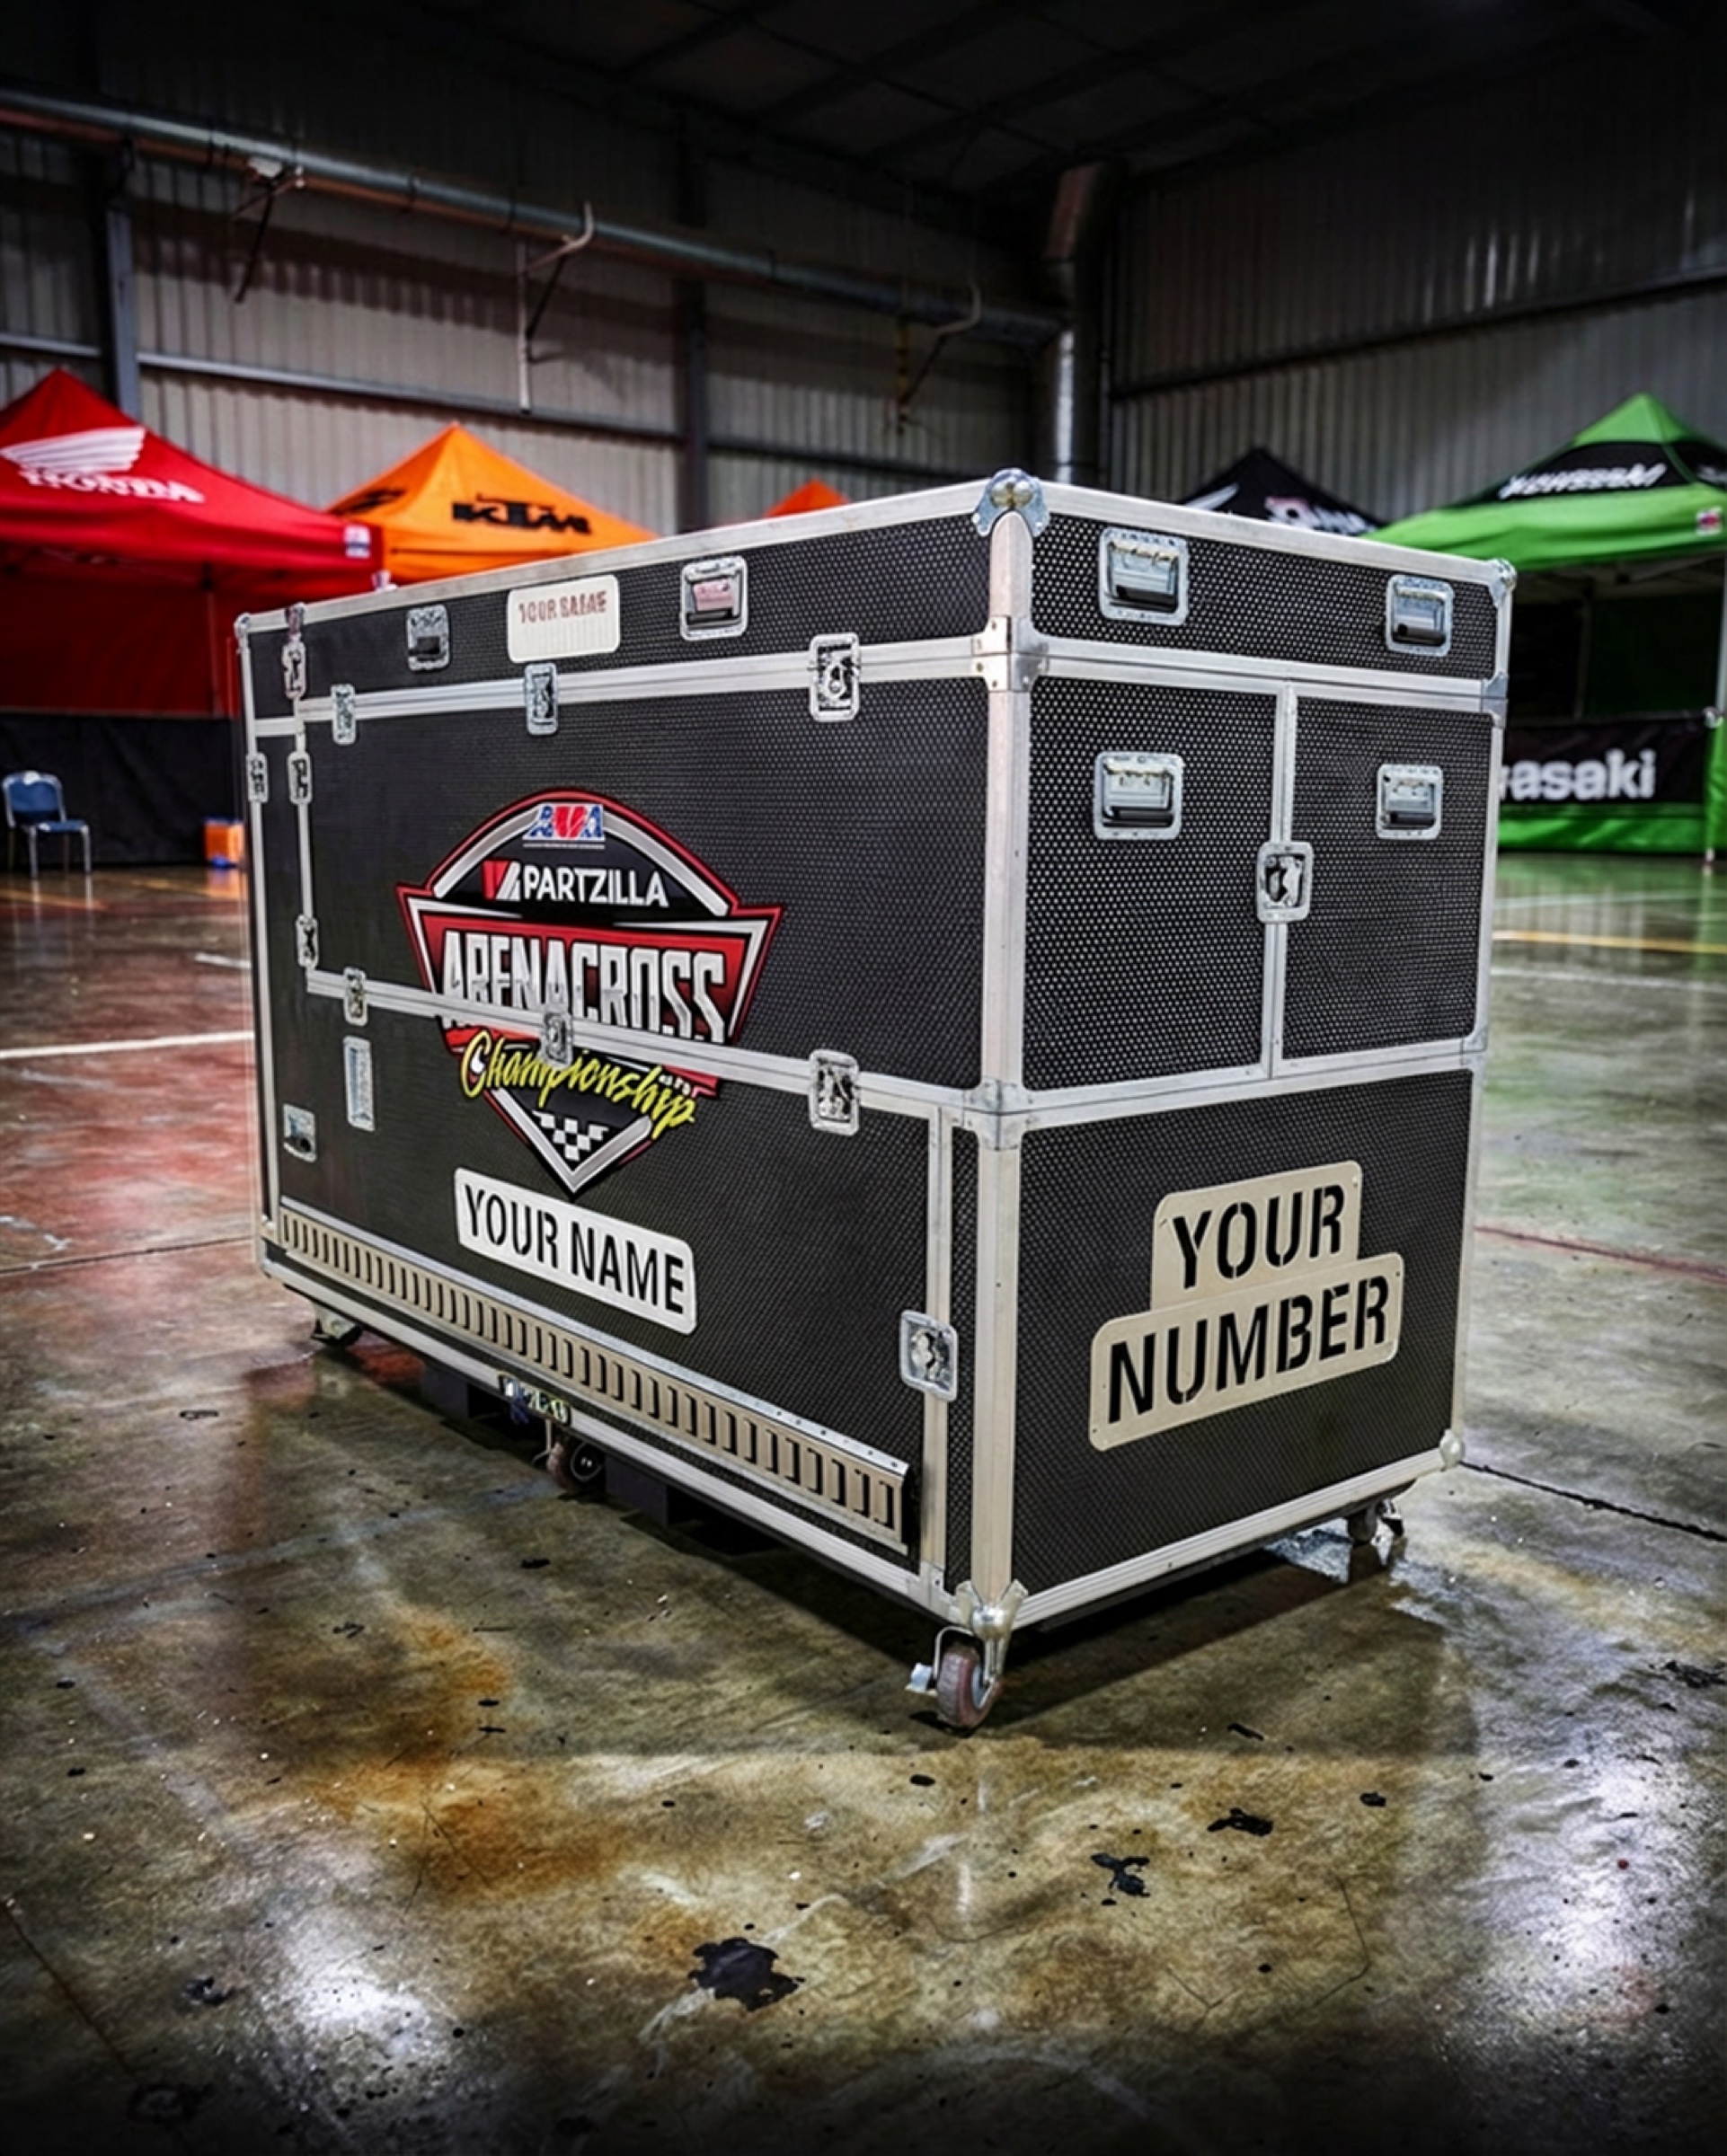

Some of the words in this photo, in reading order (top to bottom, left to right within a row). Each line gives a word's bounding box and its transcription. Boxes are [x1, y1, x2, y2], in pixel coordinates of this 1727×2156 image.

[452, 497, 591, 535] KTM
[524, 864, 669, 907] PARTZILLA
[443, 929, 725, 1044] ARENACROSS
[465, 1183, 559, 1269] YOUR
[571, 1220, 684, 1314] NAME
[1172, 1184, 1345, 1290] YOUR
[1107, 1275, 1389, 1424] NUMBER
